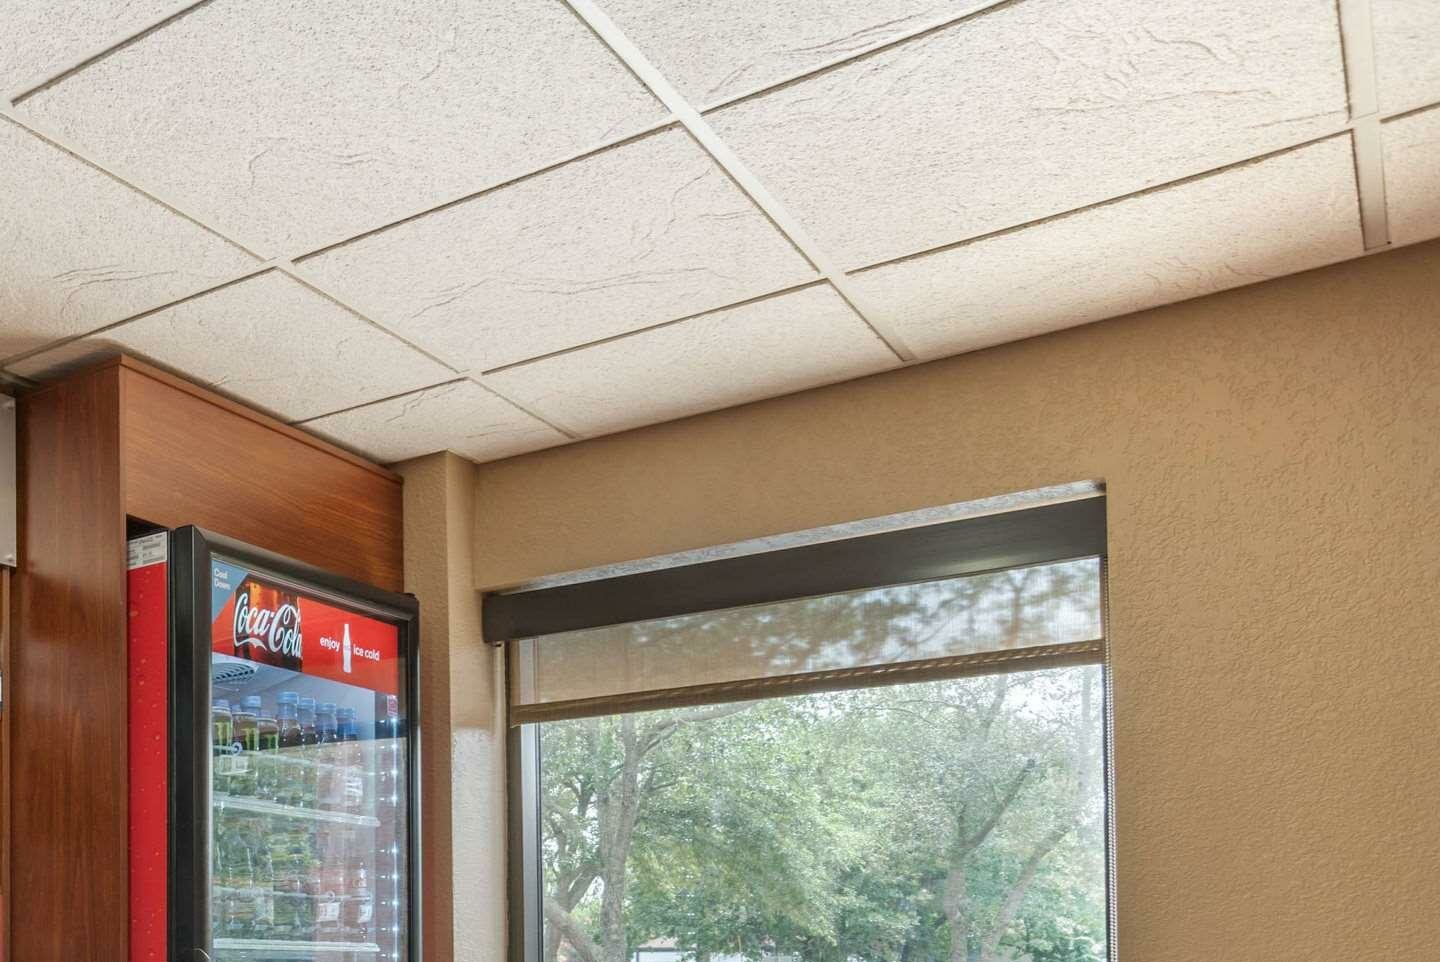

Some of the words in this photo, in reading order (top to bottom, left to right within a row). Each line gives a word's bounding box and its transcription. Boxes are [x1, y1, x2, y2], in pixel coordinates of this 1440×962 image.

[233, 593, 303, 659] Coca-Cola
[320, 636, 340, 652] enjoy
[353, 644, 365, 655] ice
[364, 649, 380, 661] cold
